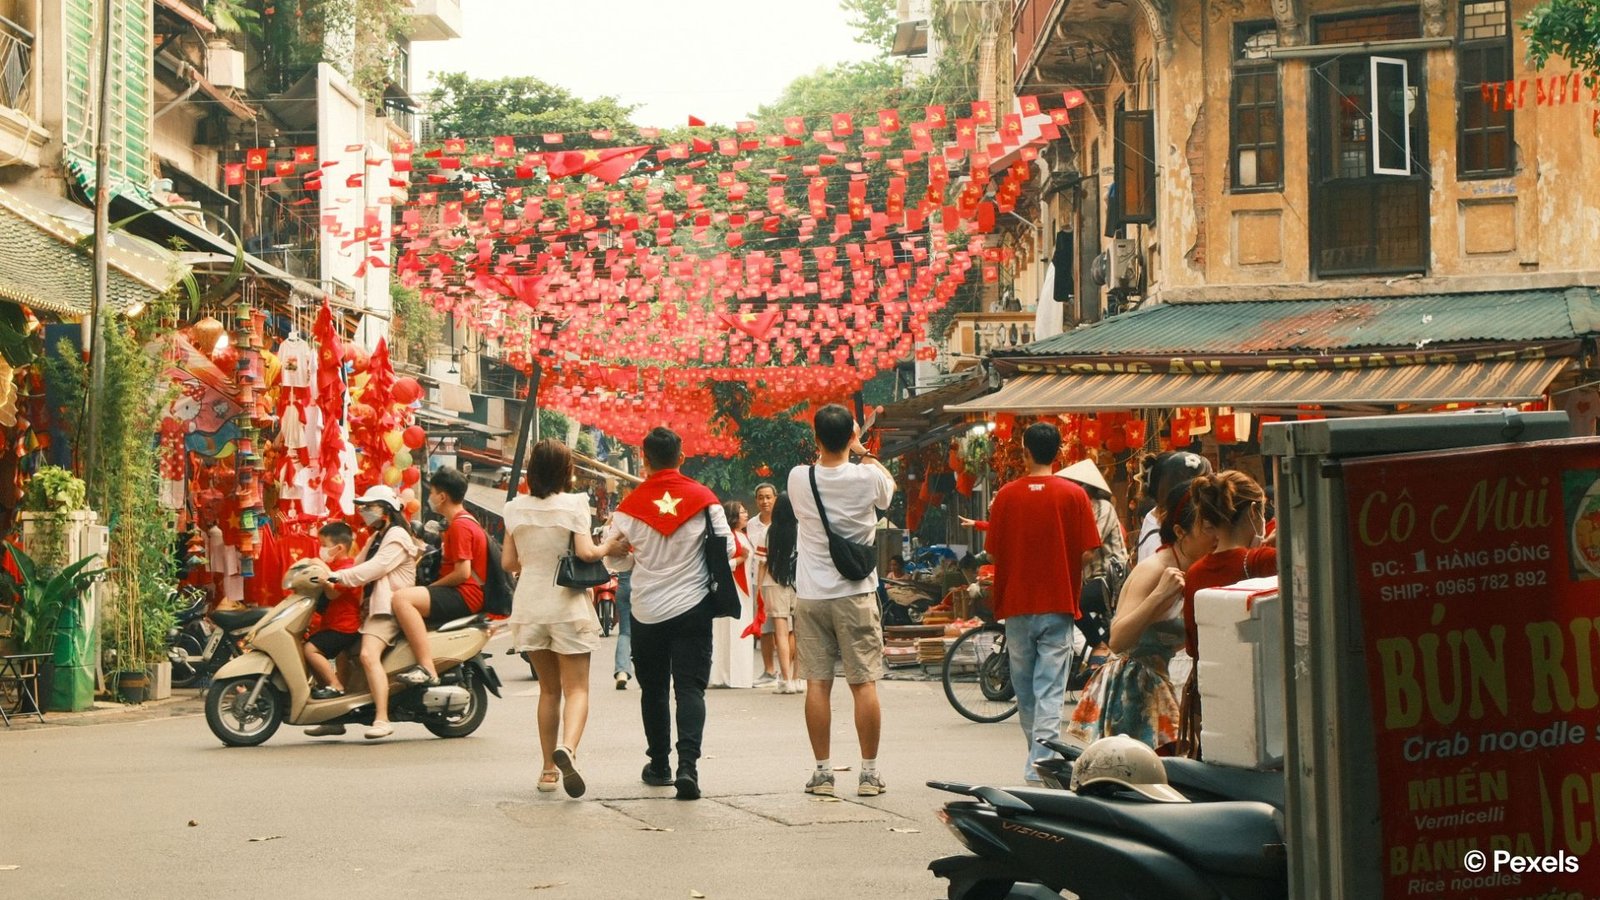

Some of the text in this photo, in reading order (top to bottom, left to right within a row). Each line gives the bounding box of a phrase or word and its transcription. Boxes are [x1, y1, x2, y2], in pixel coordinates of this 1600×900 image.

[1358, 476, 1553, 546] Cô Mùi
[1371, 540, 1550, 578] ĐC: 1 HÀNG ĐỒNG
[1380, 569, 1547, 601] SHIP: 0965 782 892
[1376, 602, 1508, 730] BÚN
[1525, 616, 1600, 714] RI
[1403, 731, 1470, 762] Crab
[1479, 721, 1586, 752] noodle
[1001, 821, 1065, 843] VISION
[1414, 806, 1505, 831] Vermicelli
[1407, 877, 1445, 895] Rice
[1451, 873, 1522, 891] noodles
